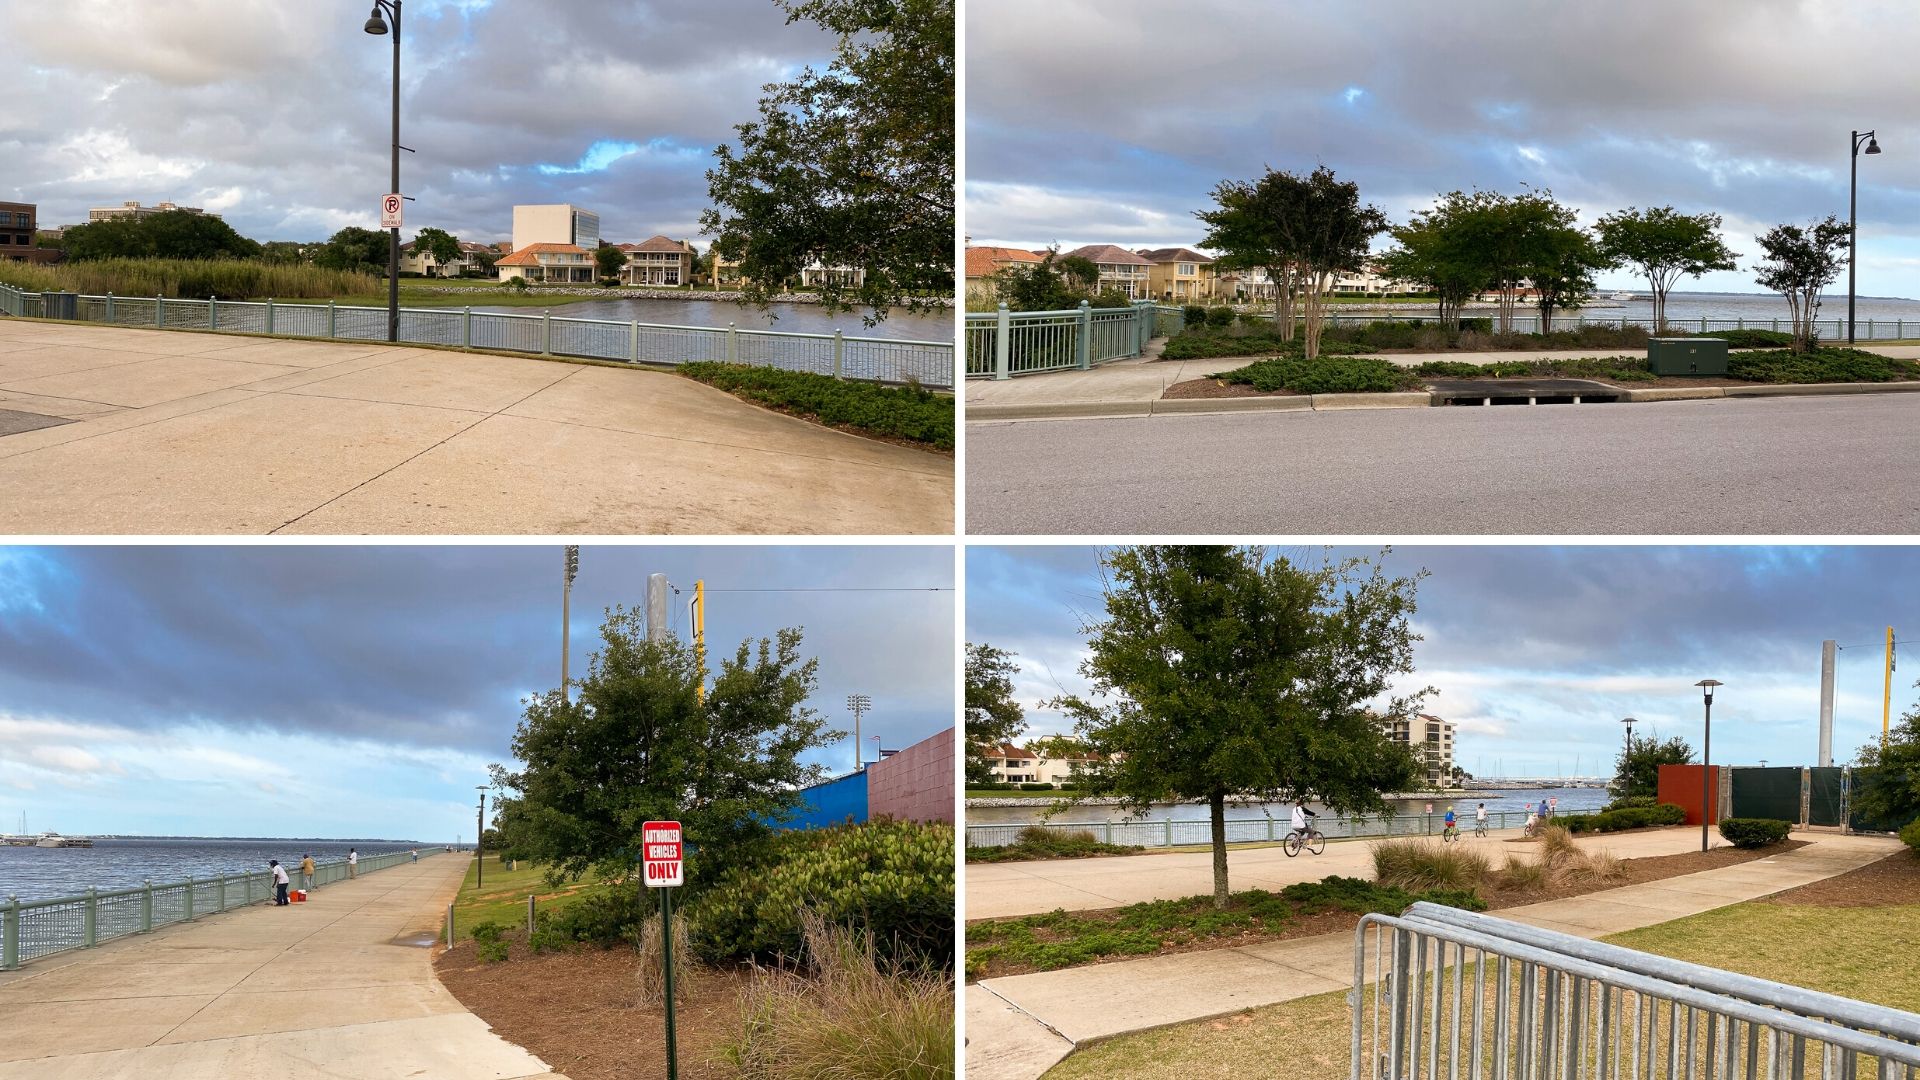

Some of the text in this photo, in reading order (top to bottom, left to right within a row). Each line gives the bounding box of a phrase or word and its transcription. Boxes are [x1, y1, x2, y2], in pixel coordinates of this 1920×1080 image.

[645, 830, 680, 843] AUTHORIZED
[649, 845, 677, 858] VEHICLES
[648, 863, 678, 880] ONLY
